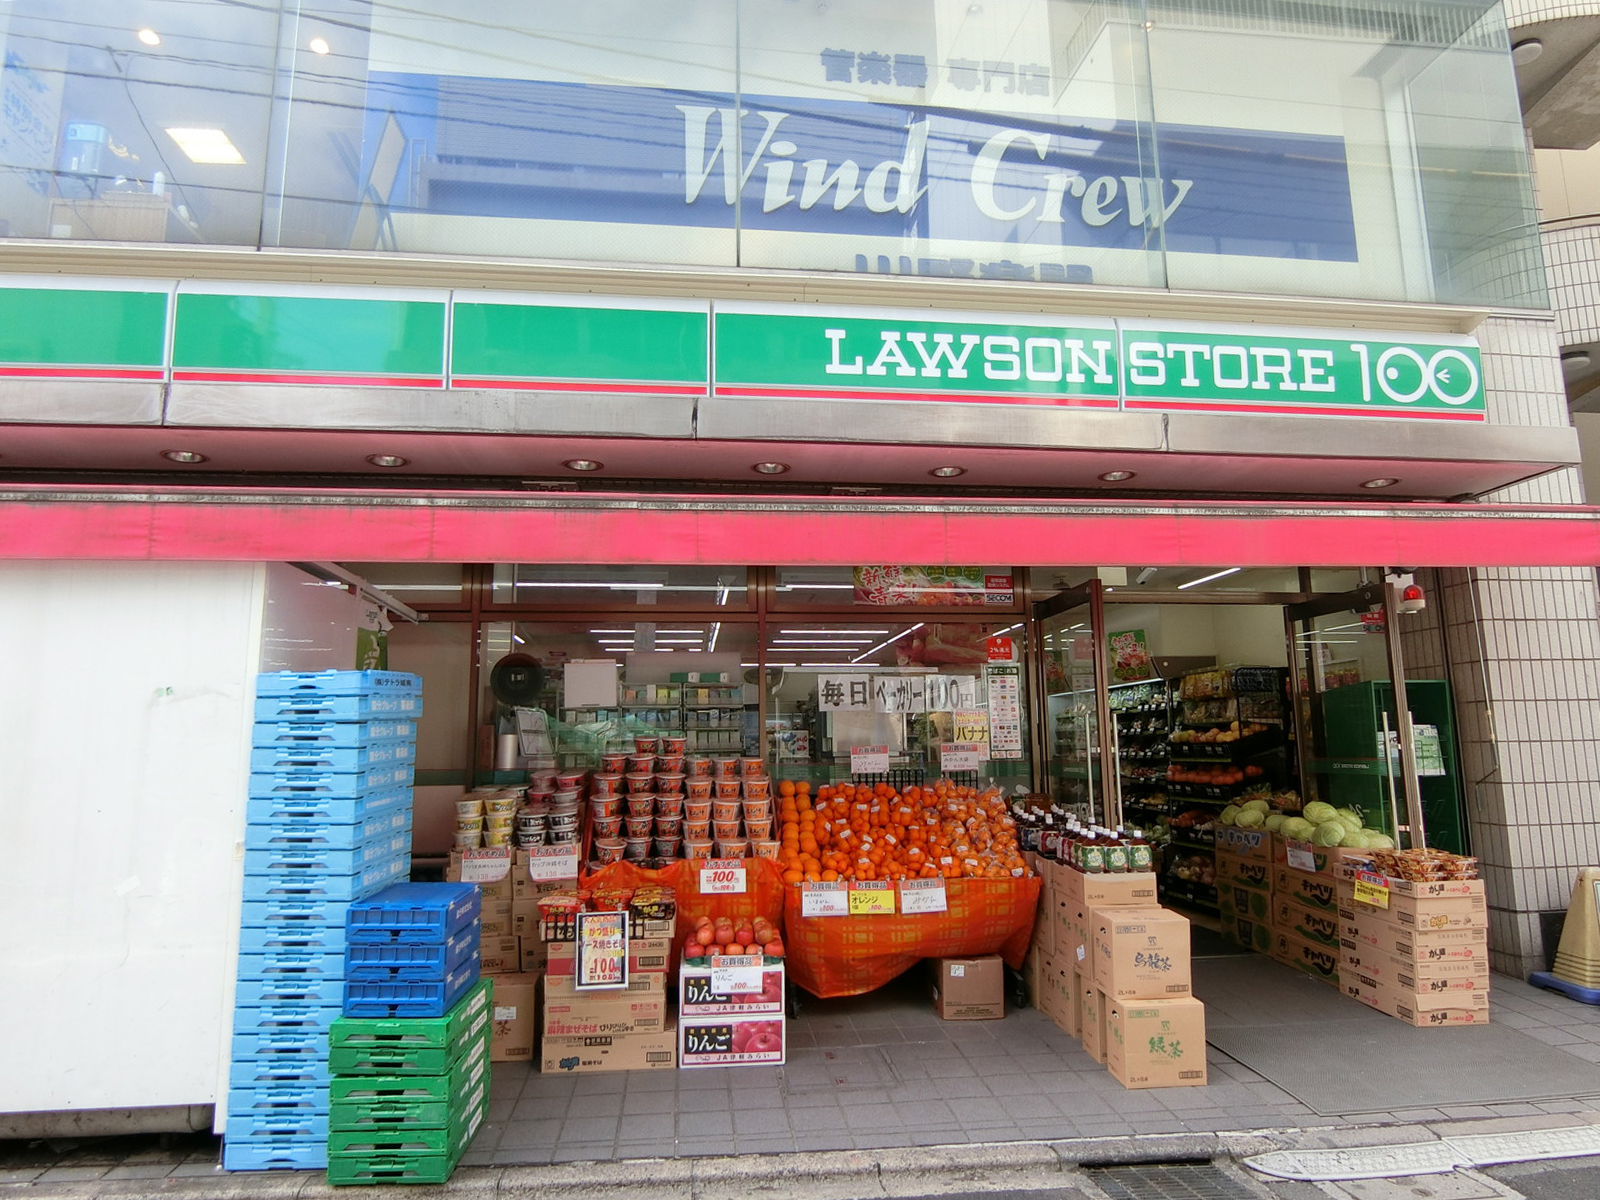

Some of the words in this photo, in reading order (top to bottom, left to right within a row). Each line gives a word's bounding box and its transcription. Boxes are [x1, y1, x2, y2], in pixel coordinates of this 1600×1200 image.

[947, 57, 1050, 98] 専門店
[675, 104, 930, 214] Wind
[970, 129, 1194, 228] Crew
[826, 329, 1113, 384] LAWSON
[1130, 342, 1336, 392] STORE
[1351, 343, 1479, 404] 100
[986, 594, 1012, 602] SECOM
[821, 679, 868, 706] 毎日
[956, 726, 988, 741] バナナ
[468, 848, 506, 858] おすすめ品
[535, 847, 572, 856] おすすめ品
[810, 882, 840, 890] お買得品
[856, 881, 887, 889] お買得品
[909, 880, 937, 888] お買得品
[851, 896, 878, 904] オレンジ
[721, 957, 753, 966] お買得品
[1134, 951, 1172, 973] 烏龍茶
[687, 1034, 731, 1051] りんご
[1148, 1035, 1184, 1059] 緑茶
